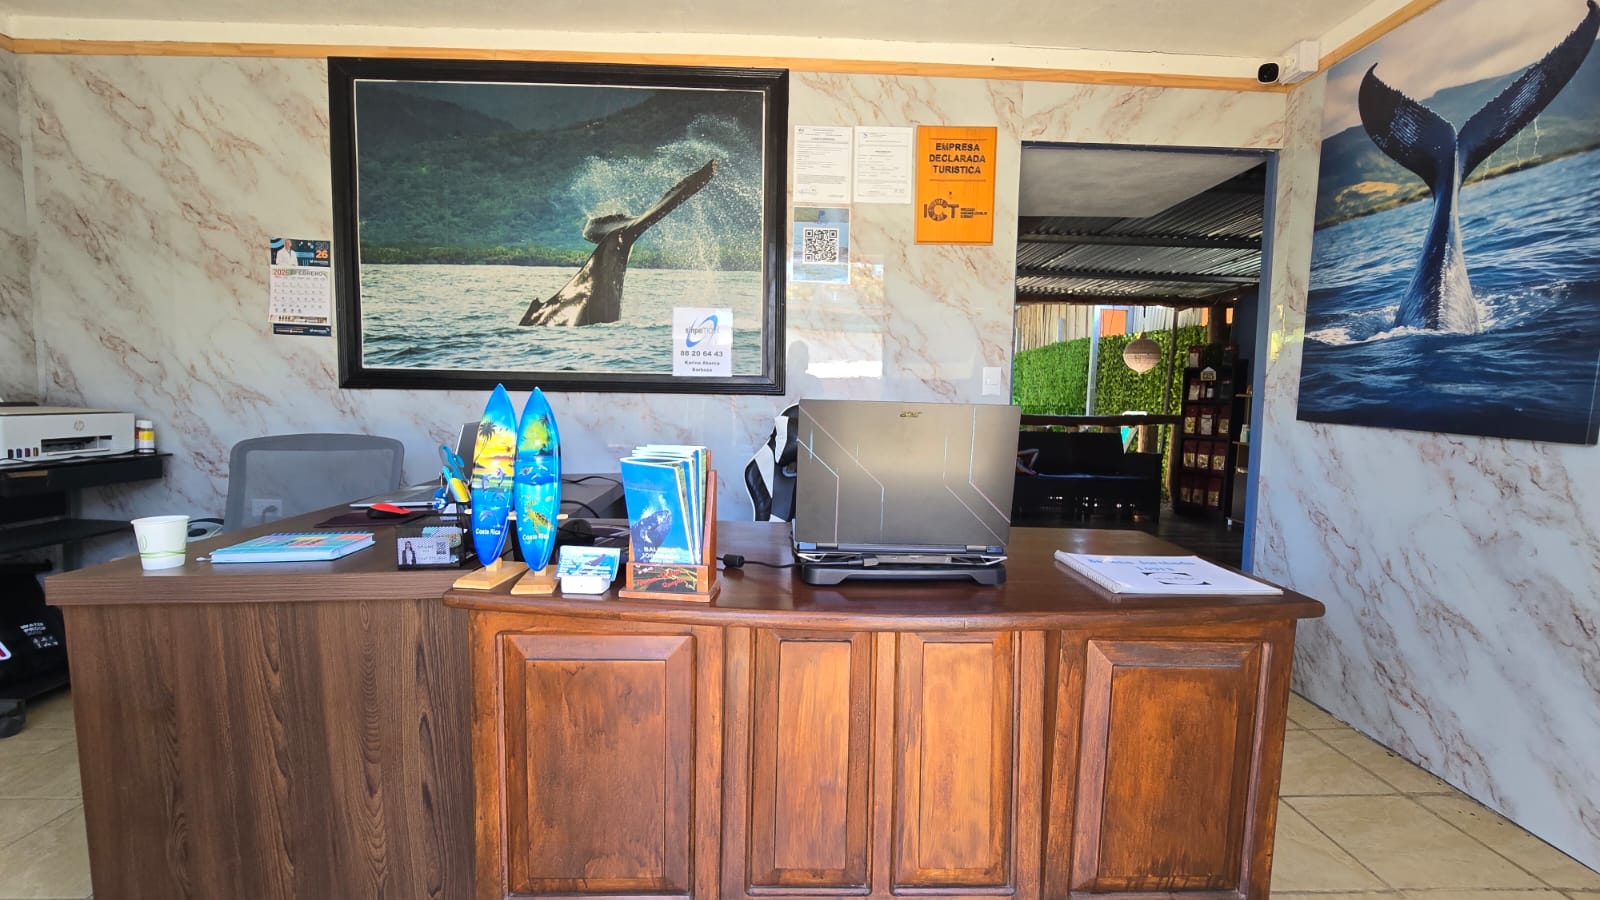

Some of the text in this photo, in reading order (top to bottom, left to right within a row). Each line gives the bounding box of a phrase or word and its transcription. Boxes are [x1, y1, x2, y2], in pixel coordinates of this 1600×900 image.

[935, 142, 981, 152] EMPRESA
[928, 154, 986, 163] DECLARADA
[933, 164, 981, 174] TURISTICA
[923, 198, 960, 222] ICT
[316, 250, 328, 259] 26
[475, 527, 490, 535] Costa
[522, 532, 550, 542] Costa Rica
